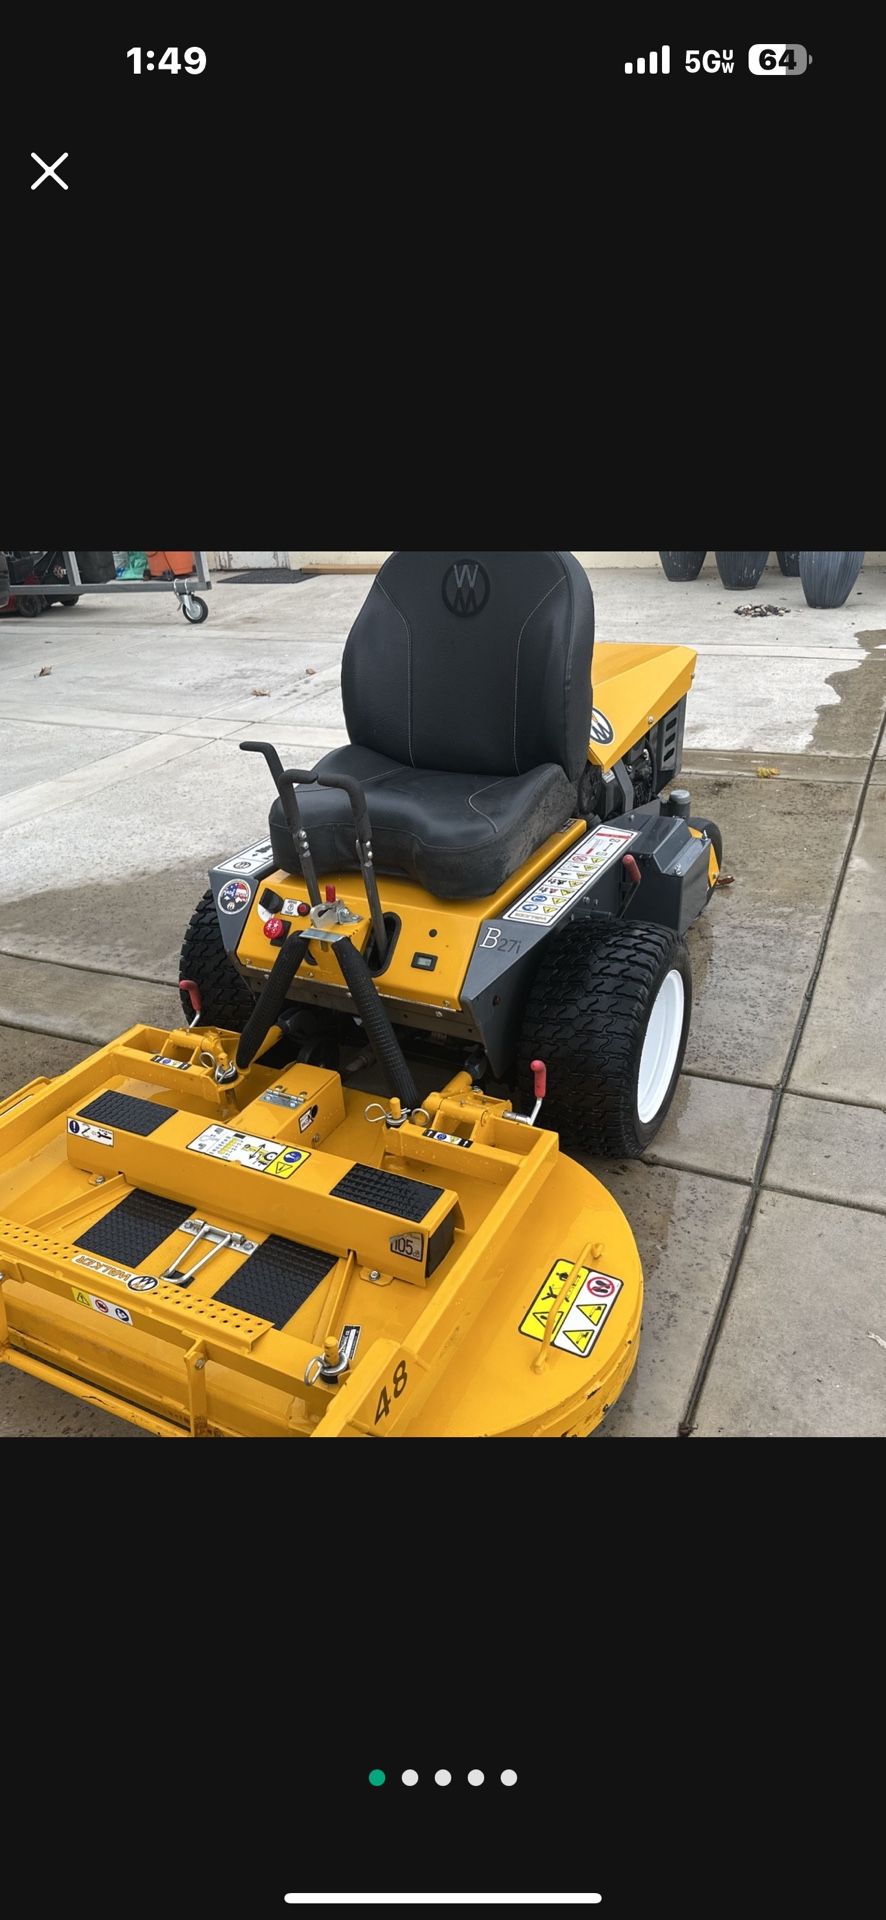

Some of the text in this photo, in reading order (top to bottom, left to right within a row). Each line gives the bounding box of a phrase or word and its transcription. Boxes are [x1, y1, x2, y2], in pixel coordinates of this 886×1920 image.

[395, 1237, 413, 1255] 105
[75, 1255, 132, 1282] WALKER
[374, 1360, 408, 1426] 48
